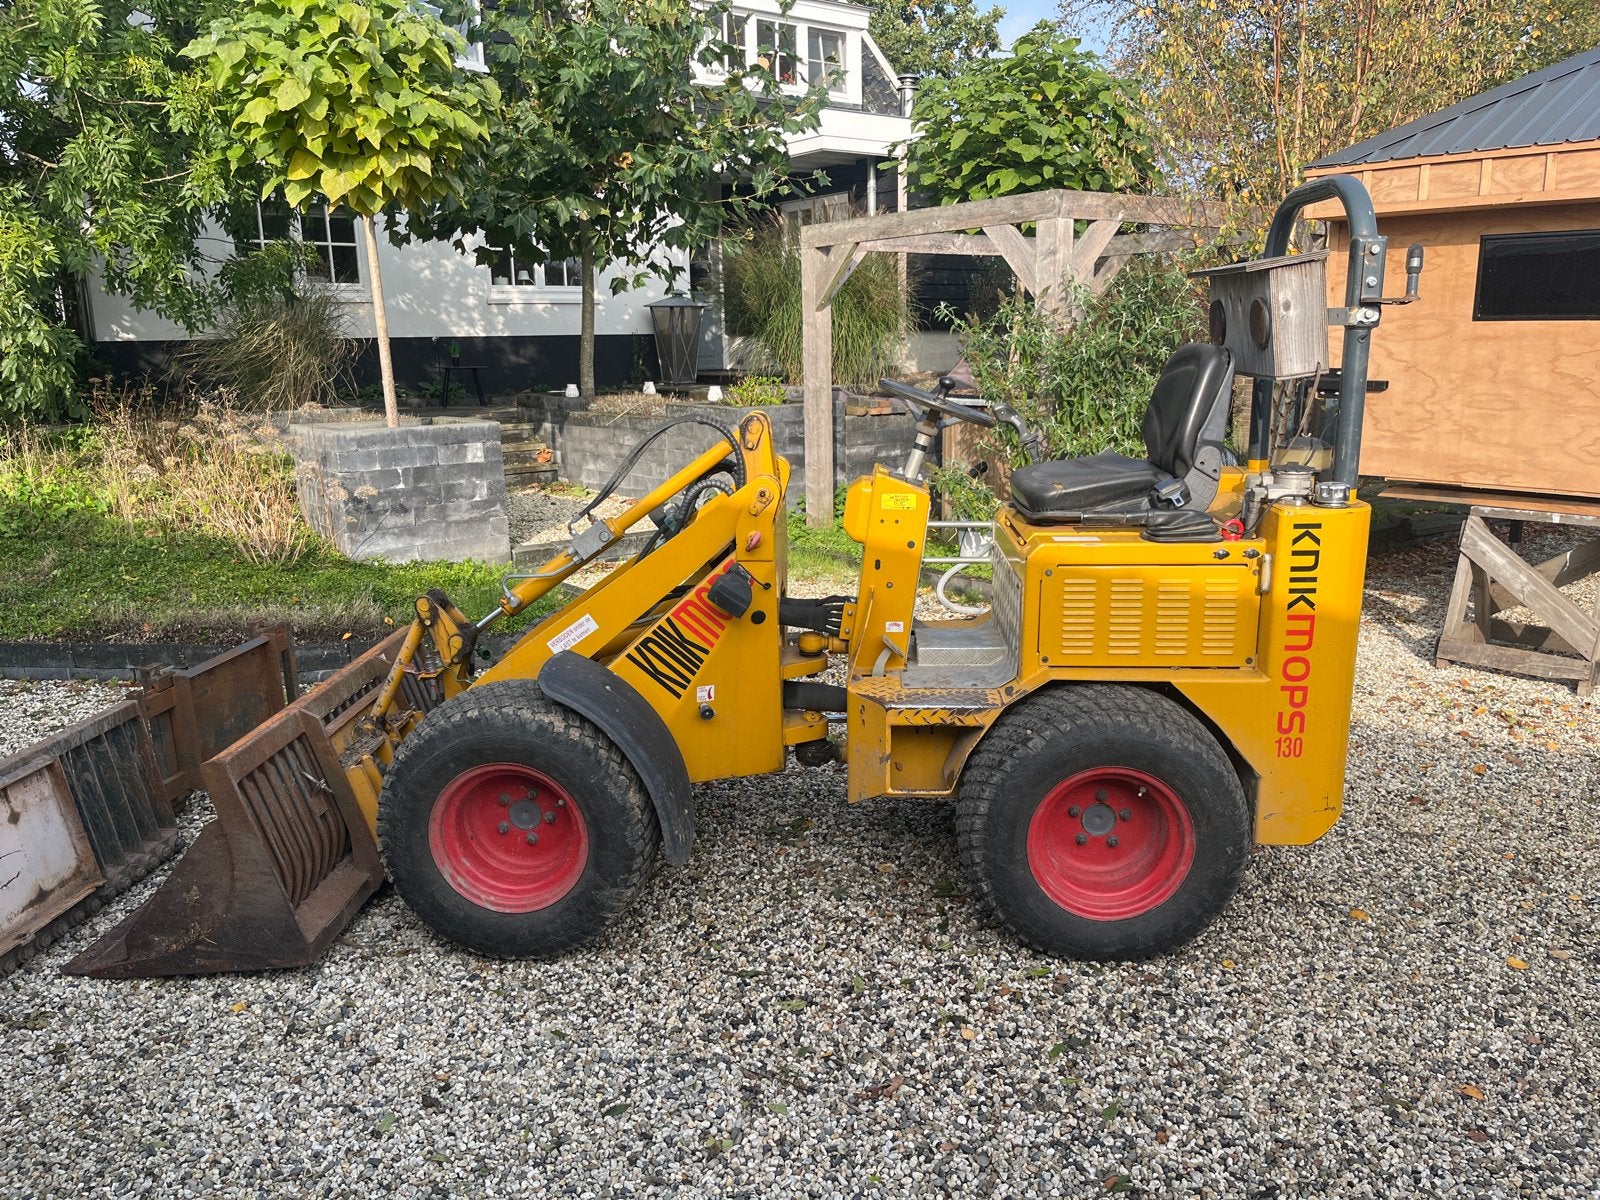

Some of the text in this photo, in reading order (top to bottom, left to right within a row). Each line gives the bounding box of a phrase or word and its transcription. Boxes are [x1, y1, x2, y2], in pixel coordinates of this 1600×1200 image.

[549, 629, 574, 648] VERBODEN
[573, 621, 586, 632] onder
[626, 558, 755, 699] KNIKMO
[1275, 737, 1303, 758] 130
